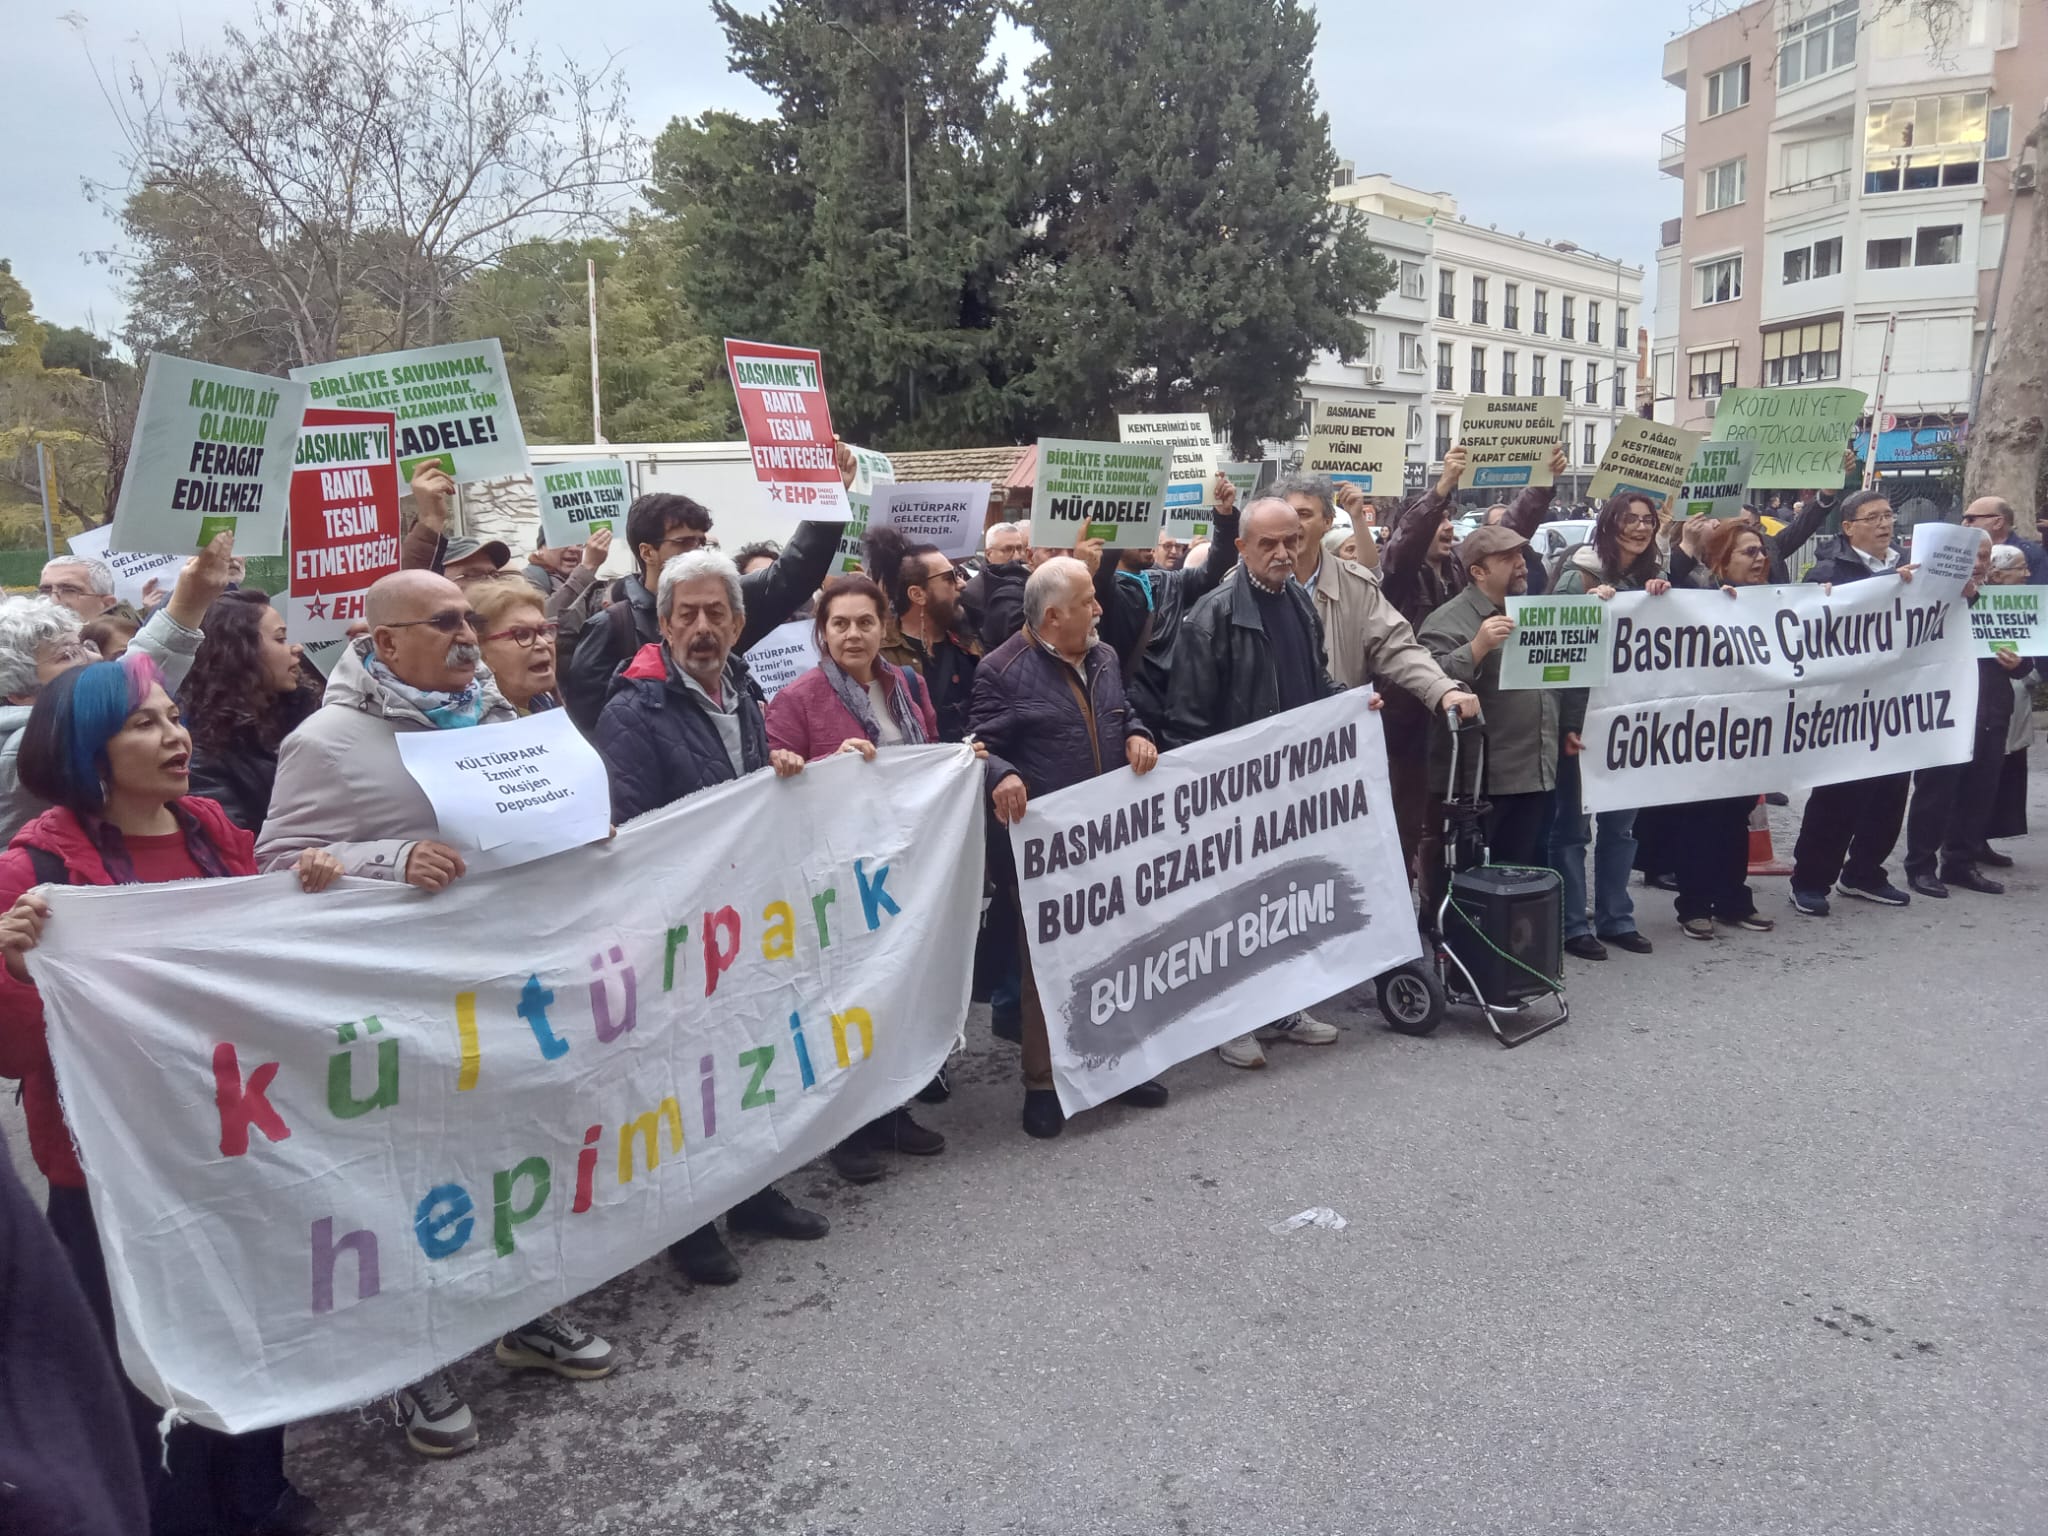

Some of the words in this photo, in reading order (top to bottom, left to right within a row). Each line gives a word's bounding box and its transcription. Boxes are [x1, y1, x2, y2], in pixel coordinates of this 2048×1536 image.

[310, 370, 389, 400] BİRLİKTE
[393, 356, 493, 385] SAVUNMAK,
[735, 362, 817, 388] BASMANE'Yİ
[189, 378, 255, 415] KAMUYA
[256, 387, 280, 418] AİT
[403, 379, 476, 400] KORUMAK,
[469, 393, 498, 412] İÇİN
[761, 391, 806, 414] RANTA
[1327, 406, 1377, 419] BASMANE
[1487, 402, 1538, 412] BASMANE
[1788, 394, 1847, 417] NİYET
[199, 413, 267, 446] OLANDAN
[766, 416, 814, 441] TESLİM
[1128, 421, 1189, 433] KENTLERİMİZİ
[1190, 422, 1202, 431] DE
[1314, 424, 1349, 437] ÇUKURU
[1351, 426, 1395, 437] BETON
[1462, 420, 1522, 432] ÇUKURUNU
[1525, 417, 1555, 428] DEĞİL
[294, 426, 389, 465] BASMANE'Yİ
[1200, 438, 1211, 447] DE
[1328, 441, 1362, 454] YIĞINI
[1460, 437, 1499, 447] ASFALT
[1500, 436, 1559, 449] ÇUKURUNU
[1640, 430, 1648, 439] O
[1649, 432, 1678, 447] AĞACI
[189, 441, 264, 477] FERAGAT
[753, 444, 836, 469] ETMEYECEĞİZ
[1046, 448, 1101, 467] BİRLİKTE
[1104, 454, 1164, 472] SAVUNMAK,
[1173, 452, 1203, 464] TESLİM
[1472, 452, 1506, 463] KAPAT
[1507, 450, 1542, 462] CEMİL!
[1621, 440, 1683, 462] KESTİRMEDİK
[1703, 447, 1741, 467] YETKİ,
[1061, 465, 1105, 481] BİRLİKTE
[1106, 471, 1150, 483] KORUMAK,
[1311, 460, 1383, 472] OLMAYACAK!
[1611, 451, 1619, 460] O
[1620, 453, 1675, 474] GÖKDELENİ
[1674, 467, 1685, 476] DE
[1752, 452, 1791, 477] ZANI
[320, 469, 374, 501] RANTA
[544, 472, 584, 493] KENT
[586, 469, 623, 487] HAKKI
[1046, 480, 1090, 494] BİRLİKTE
[1093, 484, 1141, 496] KAZANMAK
[1142, 484, 1158, 498] İÇİN
[1693, 483, 1743, 499] HALKINA!
[171, 476, 264, 512] EDİLEMEZ!
[552, 491, 594, 509] RANTA
[593, 486, 624, 503] TESLİM
[785, 485, 817, 504] EHP
[567, 504, 620, 523] EDİLEMEZ!
[891, 501, 968, 514] KÜLTÜRPARK
[1050, 495, 1151, 522] MÜCADELE!
[322, 502, 378, 539] TESLİM
[894, 514, 960, 524] GELECEKTİR,
[296, 535, 398, 580] ETMEYECEĞİZ
[332, 595, 367, 620] EH
[1993, 595, 2038, 610] HAKKI
[1519, 607, 1556, 626] KENT
[1561, 606, 1602, 625] HAKKI
[1971, 613, 1994, 625] NTA
[1998, 611, 2038, 625] TESLİM
[1519, 630, 1557, 646] RANTA
[1561, 626, 1599, 645] TESLİM
[1612, 617, 1771, 674] Basmane
[1775, 597, 1950, 677] Çukuru'nda
[744, 644, 805, 662] ÜLTÜRPARK
[1528, 646, 1587, 664] EDİLEMEZ!
[755, 659, 793, 673] İzmir'in
[760, 670, 797, 683] Oksijen
[1606, 707, 1772, 771] Gökdelen
[1783, 688, 1956, 755] İstemiyoruz
[455, 745, 549, 771] KÜLTÜRPARK
[482, 764, 539, 782] İzmir'in
[499, 777, 551, 796] Oksijen
[496, 787, 575, 814] Deposudur.
[1023, 793, 1165, 880] BASMANE
[1174, 723, 1358, 834] ÇUKURU'NDAN
[1038, 876, 1125, 945] BUCA
[1135, 816, 1243, 906] CEZAEVİ
[1251, 779, 1369, 859] ALANINA
[1089, 965, 1138, 1026] BU
[1143, 919, 1234, 1000] KENT
[1238, 879, 1335, 957] BİZİM!
[211, 858, 901, 1157] kültürpark
[310, 1006, 875, 1314] hepimizin
